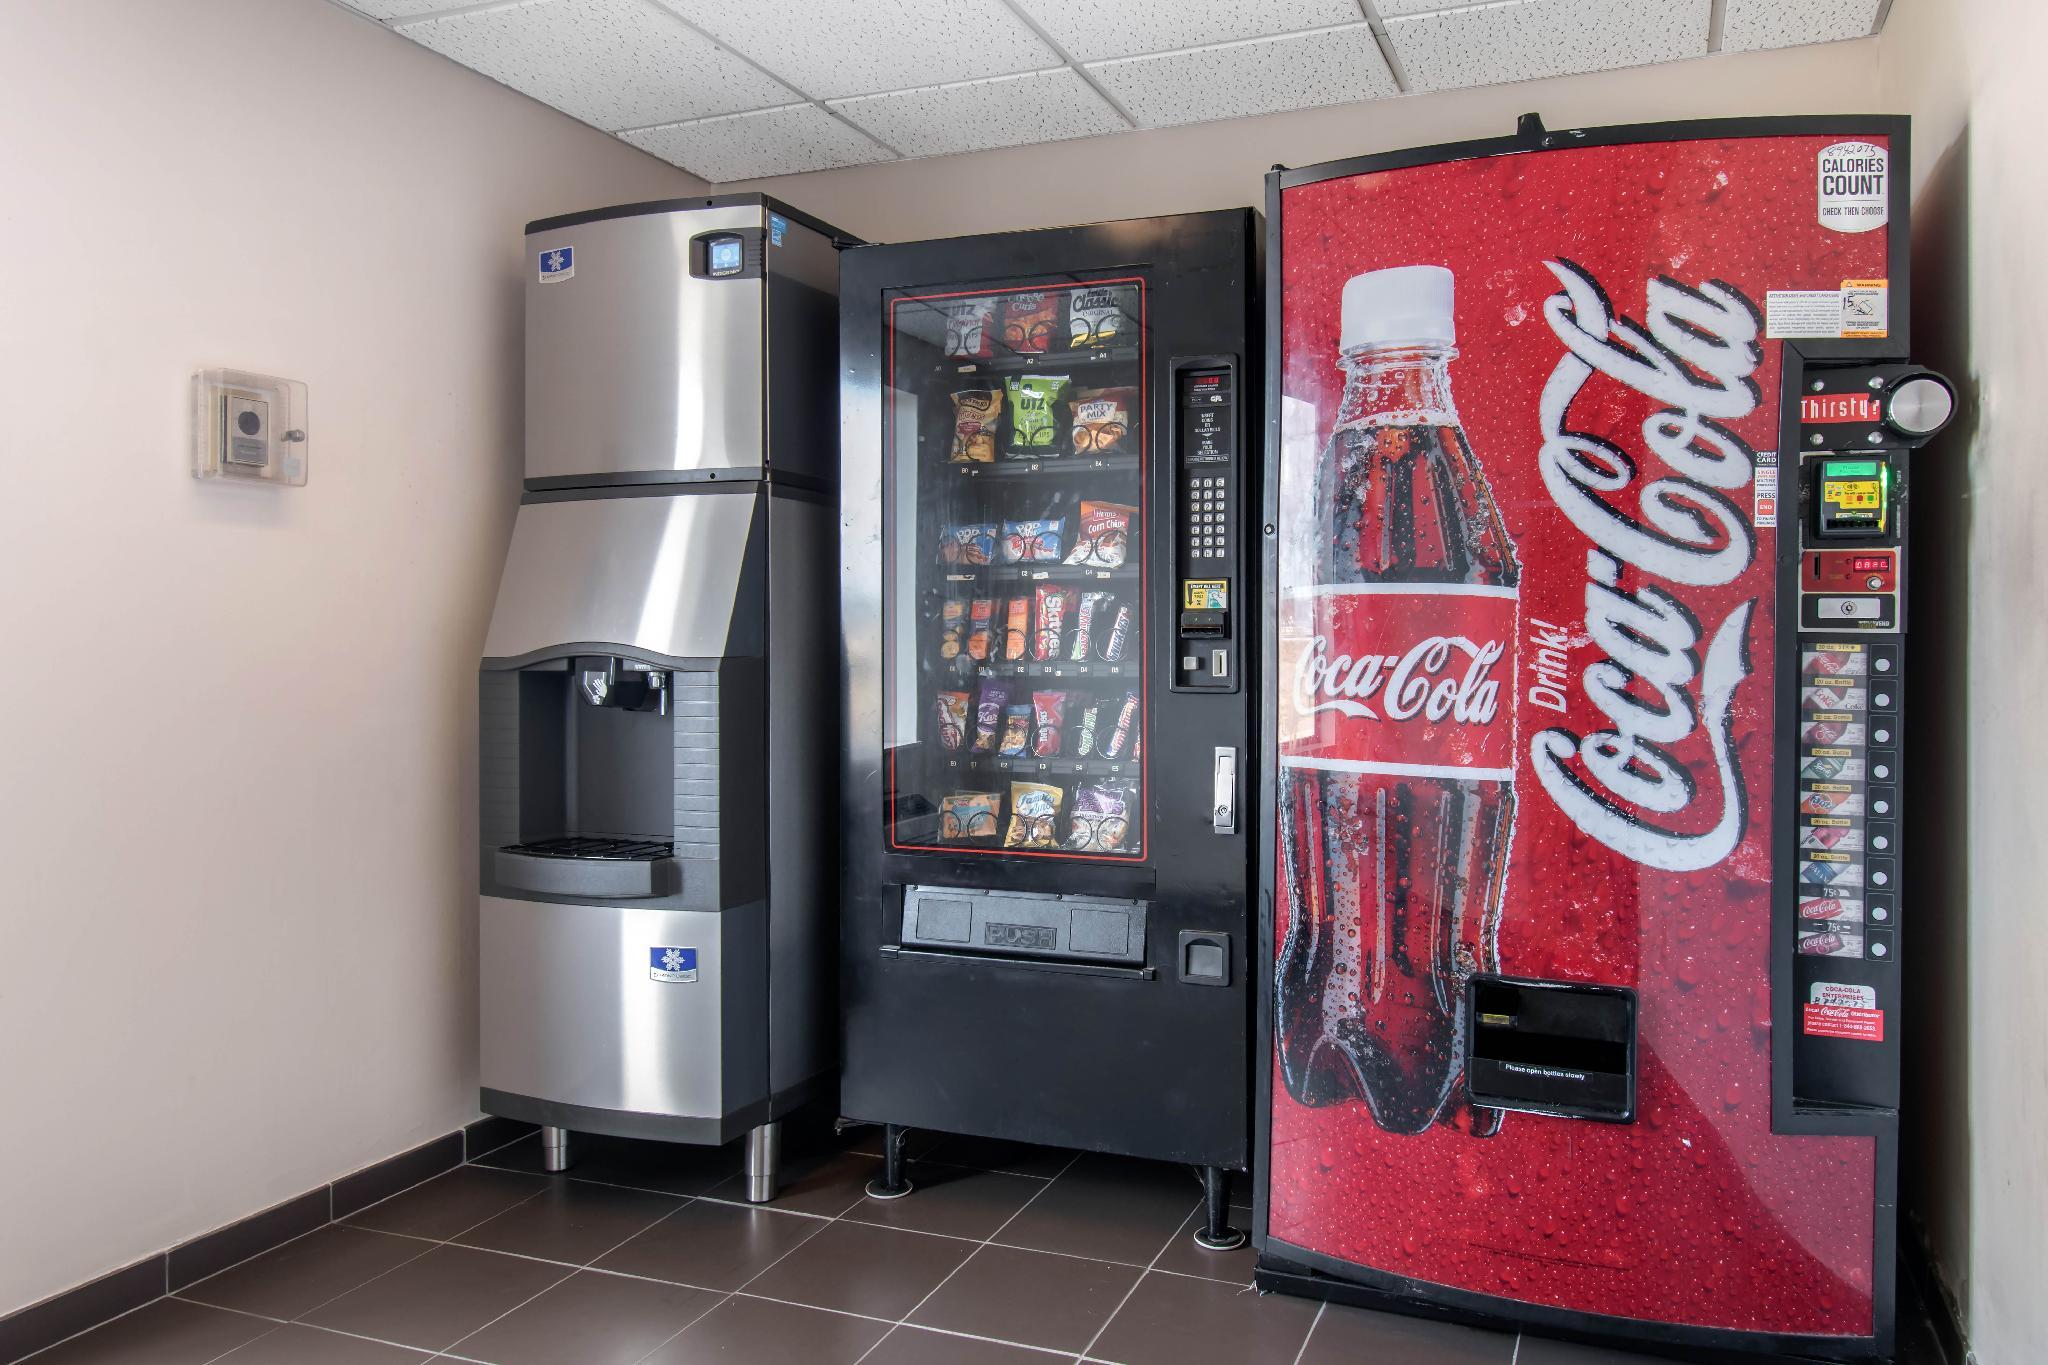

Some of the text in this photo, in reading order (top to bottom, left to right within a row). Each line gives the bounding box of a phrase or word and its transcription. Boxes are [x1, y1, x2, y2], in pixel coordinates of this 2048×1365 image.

[1822, 158, 1884, 173] CALORIES
[1823, 175, 1884, 196] COUNT
[1822, 206, 1884, 216] CHECK THEN CHOOSE
[1021, 398, 1045, 411] UTZ
[1080, 403, 1113, 413] PARTY
[1086, 410, 1106, 418] MIX
[1088, 522, 1105, 534] Corn
[1530, 256, 1763, 874] Coca-Cola
[1529, 617, 1569, 714] Drink!
[1292, 636, 1505, 727] Coca-Cola
[1802, 899, 1837, 917] Coca-Cola
[987, 924, 1055, 947] PUSH
[1803, 933, 1837, 948] Coca-Cola
[1825, 986, 1861, 994] COCA-COLA
[1505, 1063, 1585, 1081] Please open bottles slowly
